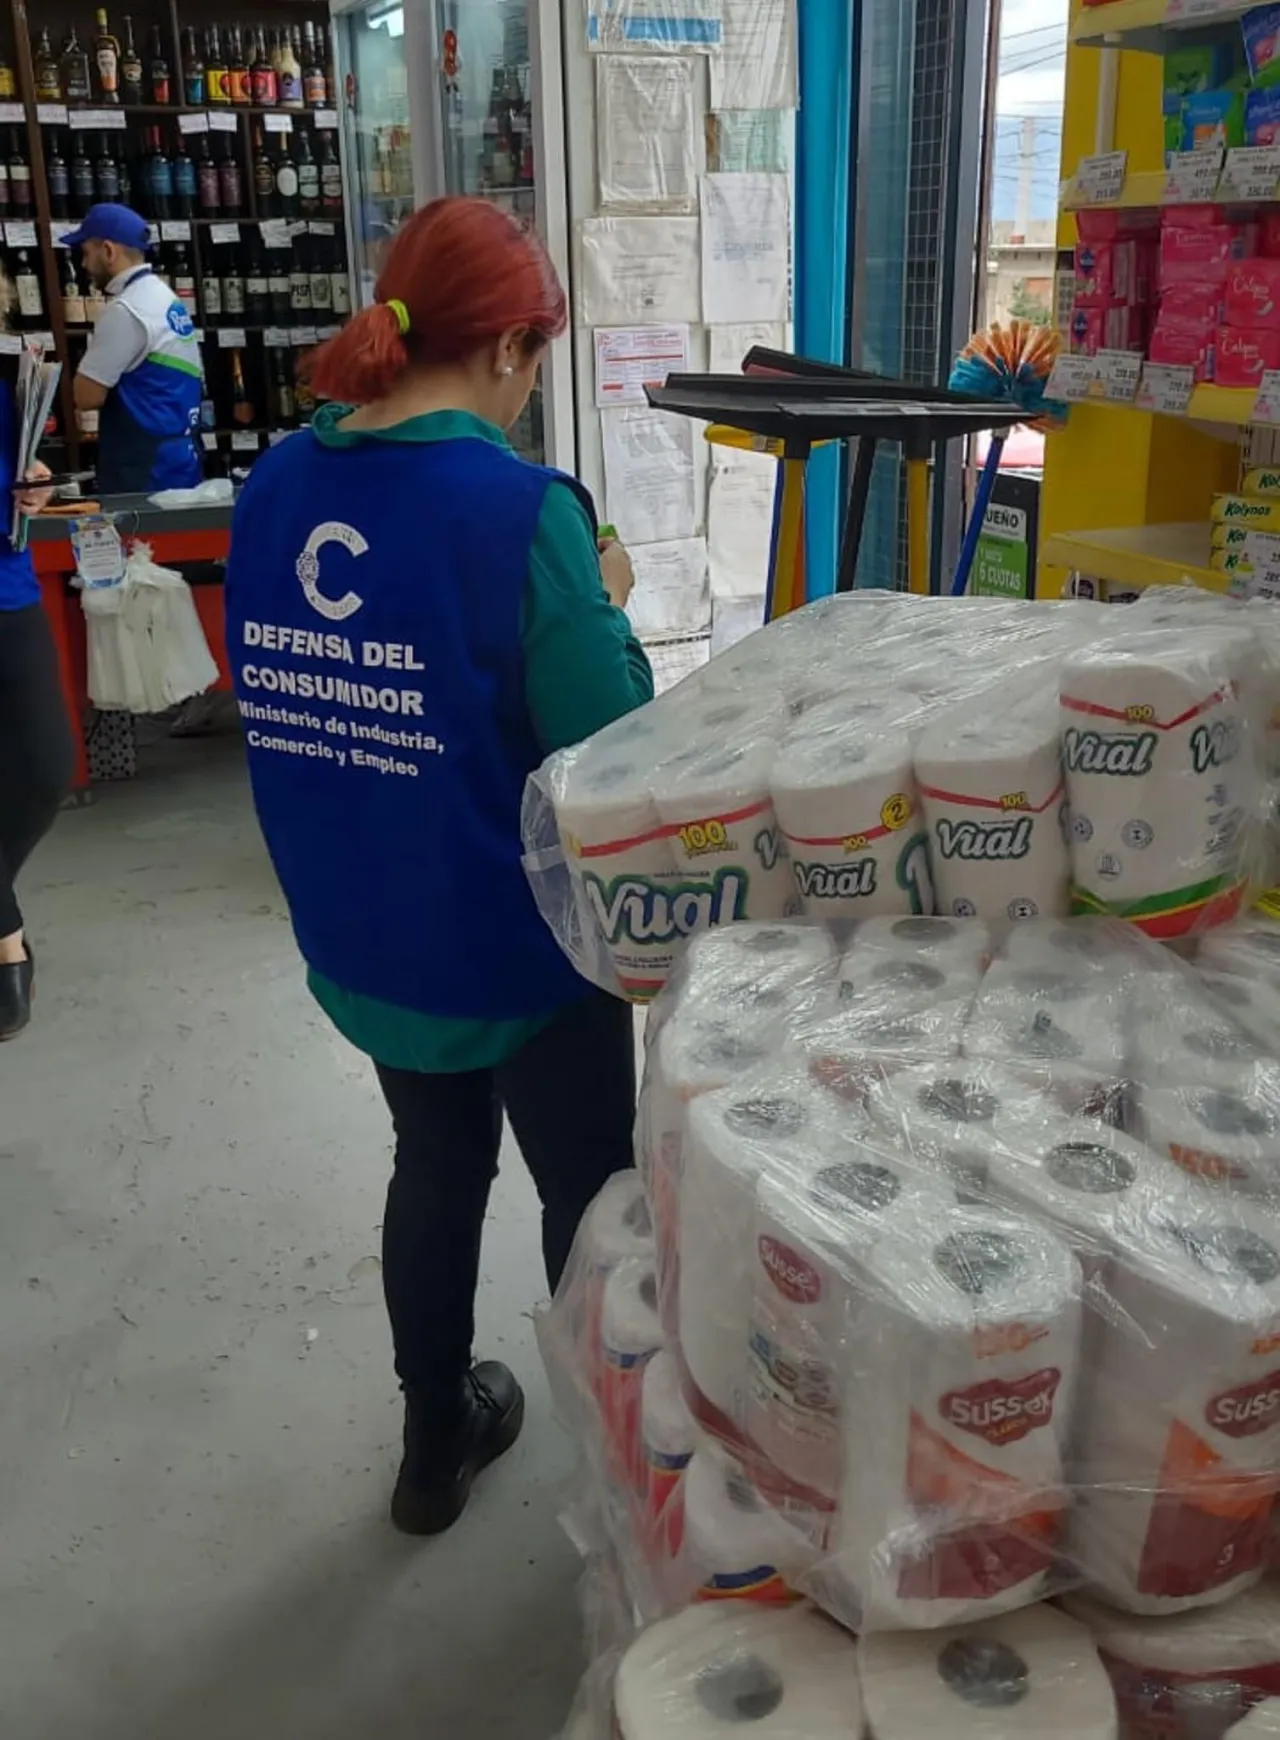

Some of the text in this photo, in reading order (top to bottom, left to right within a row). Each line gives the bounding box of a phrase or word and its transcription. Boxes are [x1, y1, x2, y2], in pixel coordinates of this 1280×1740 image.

[1258, 473, 1280, 489] Kol
[984, 508, 1019, 528] UEÑO
[1224, 501, 1271, 518] Kolynos
[988, 565, 1021, 591] CUOTAS
[244, 621, 425, 670] DEFENSA DEL
[242, 664, 424, 716] CONSUMIDOR
[238, 700, 445, 754] Ministerio de Industria,
[1126, 704, 1154, 721] 100
[247, 730, 419, 777] Comercio y Empleo
[1063, 727, 1158, 776] Vual
[1002, 792, 1027, 808] 100
[677, 818, 727, 850] 100
[936, 817, 1033, 860] Vual
[794, 857, 877, 898] Vual
[582, 866, 748, 945] Vual
[1218, 1543, 1234, 1567] 3
